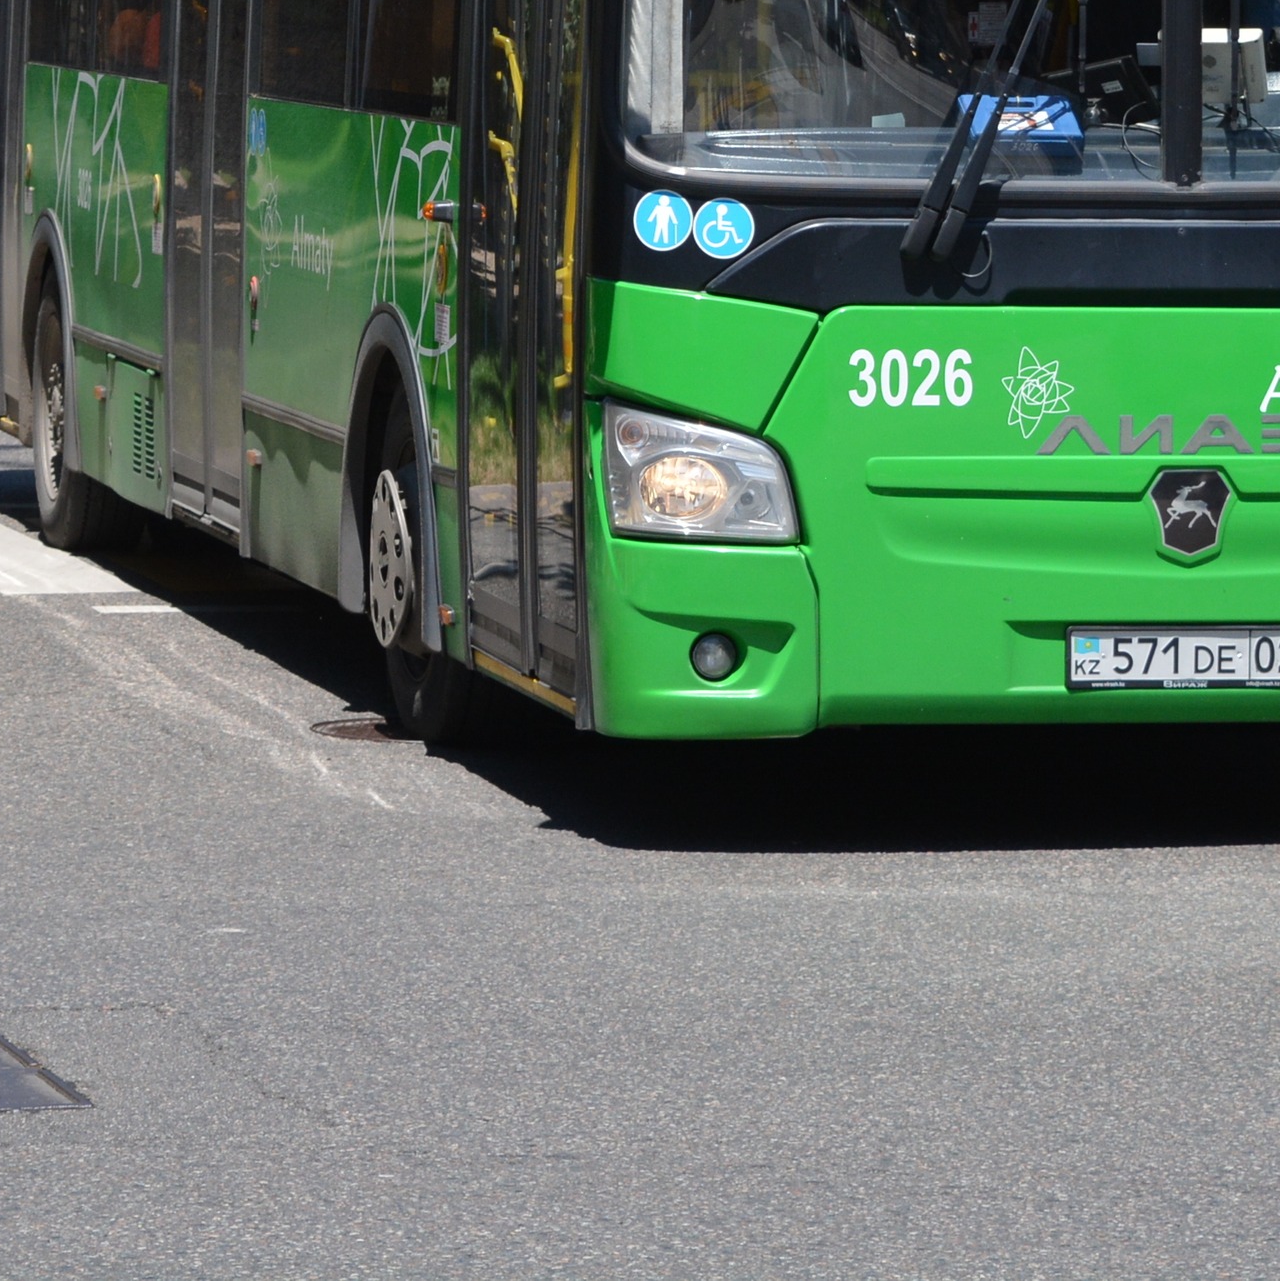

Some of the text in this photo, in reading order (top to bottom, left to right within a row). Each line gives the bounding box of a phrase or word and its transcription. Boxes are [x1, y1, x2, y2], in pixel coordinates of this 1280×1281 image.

[291, 214, 334, 292] Almaty
[848, 348, 973, 407] 3026
[1074, 659, 1101, 675] KZ
[1113, 637, 1180, 675] 571
[1194, 645, 1236, 674] DE
